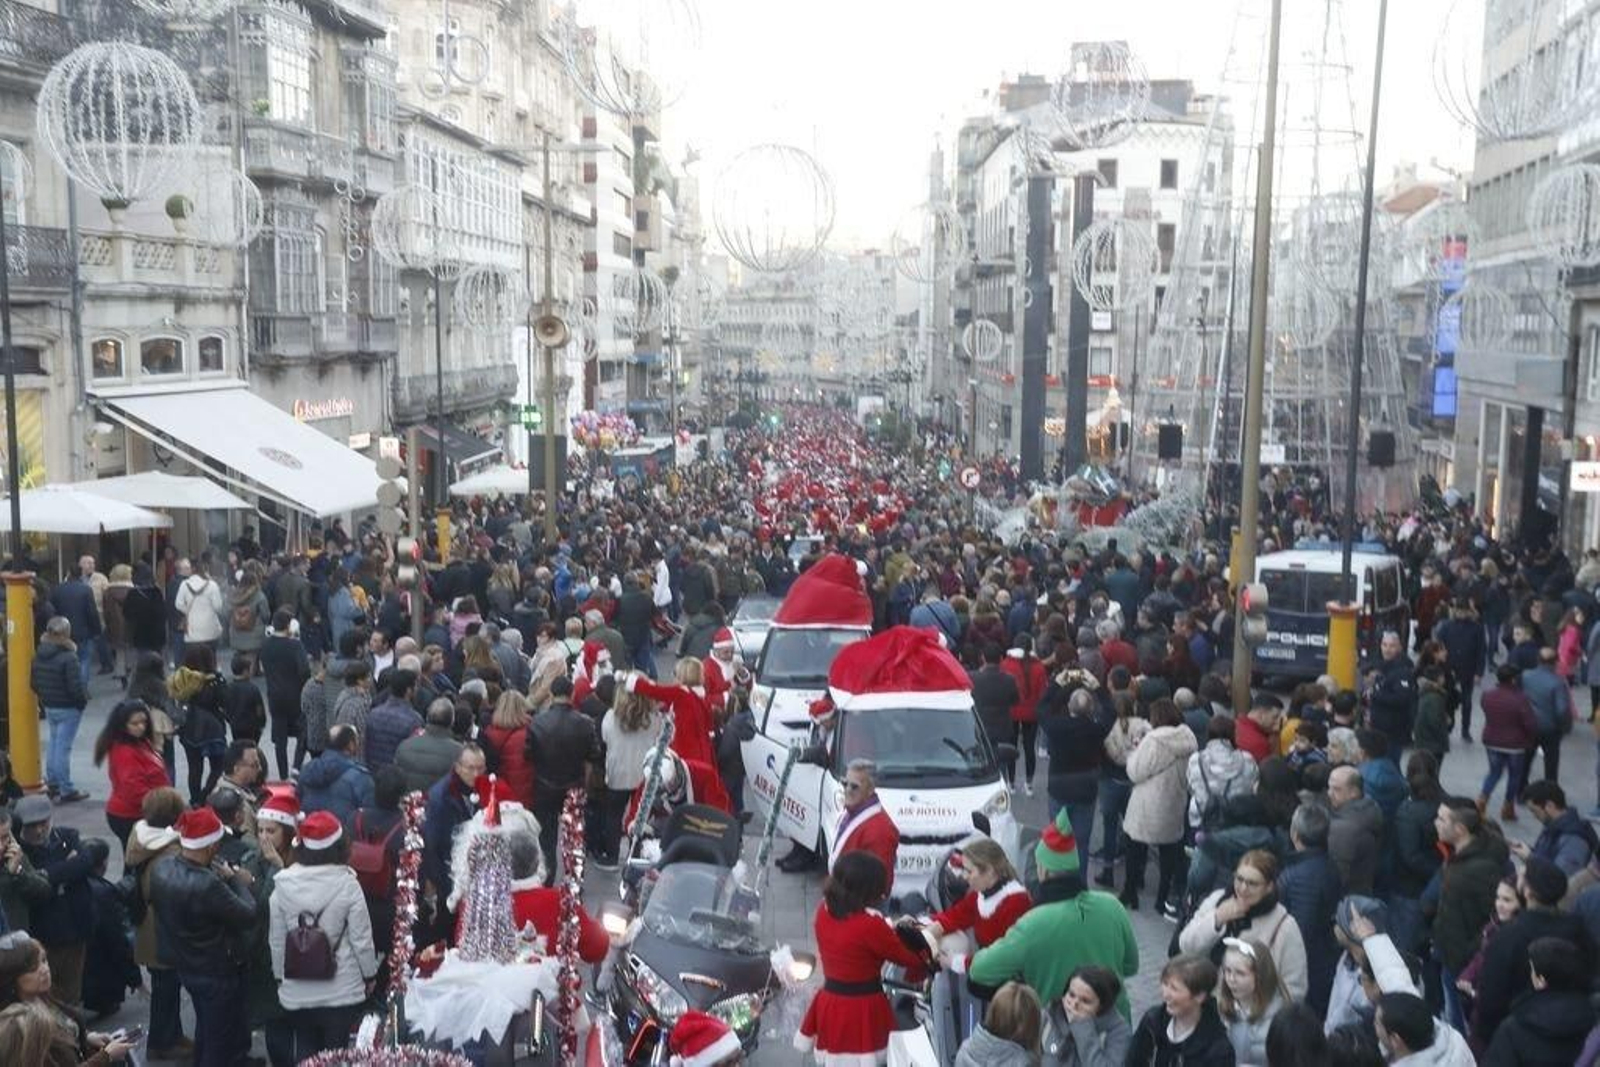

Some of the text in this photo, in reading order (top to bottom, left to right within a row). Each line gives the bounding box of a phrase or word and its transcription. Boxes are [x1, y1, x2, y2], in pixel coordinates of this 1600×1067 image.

[1266, 631, 1328, 647] POLICI
[768, 783, 807, 822] HTESS
[898, 807, 957, 816] AIR HOSTESS
[901, 856, 932, 868] 9799
